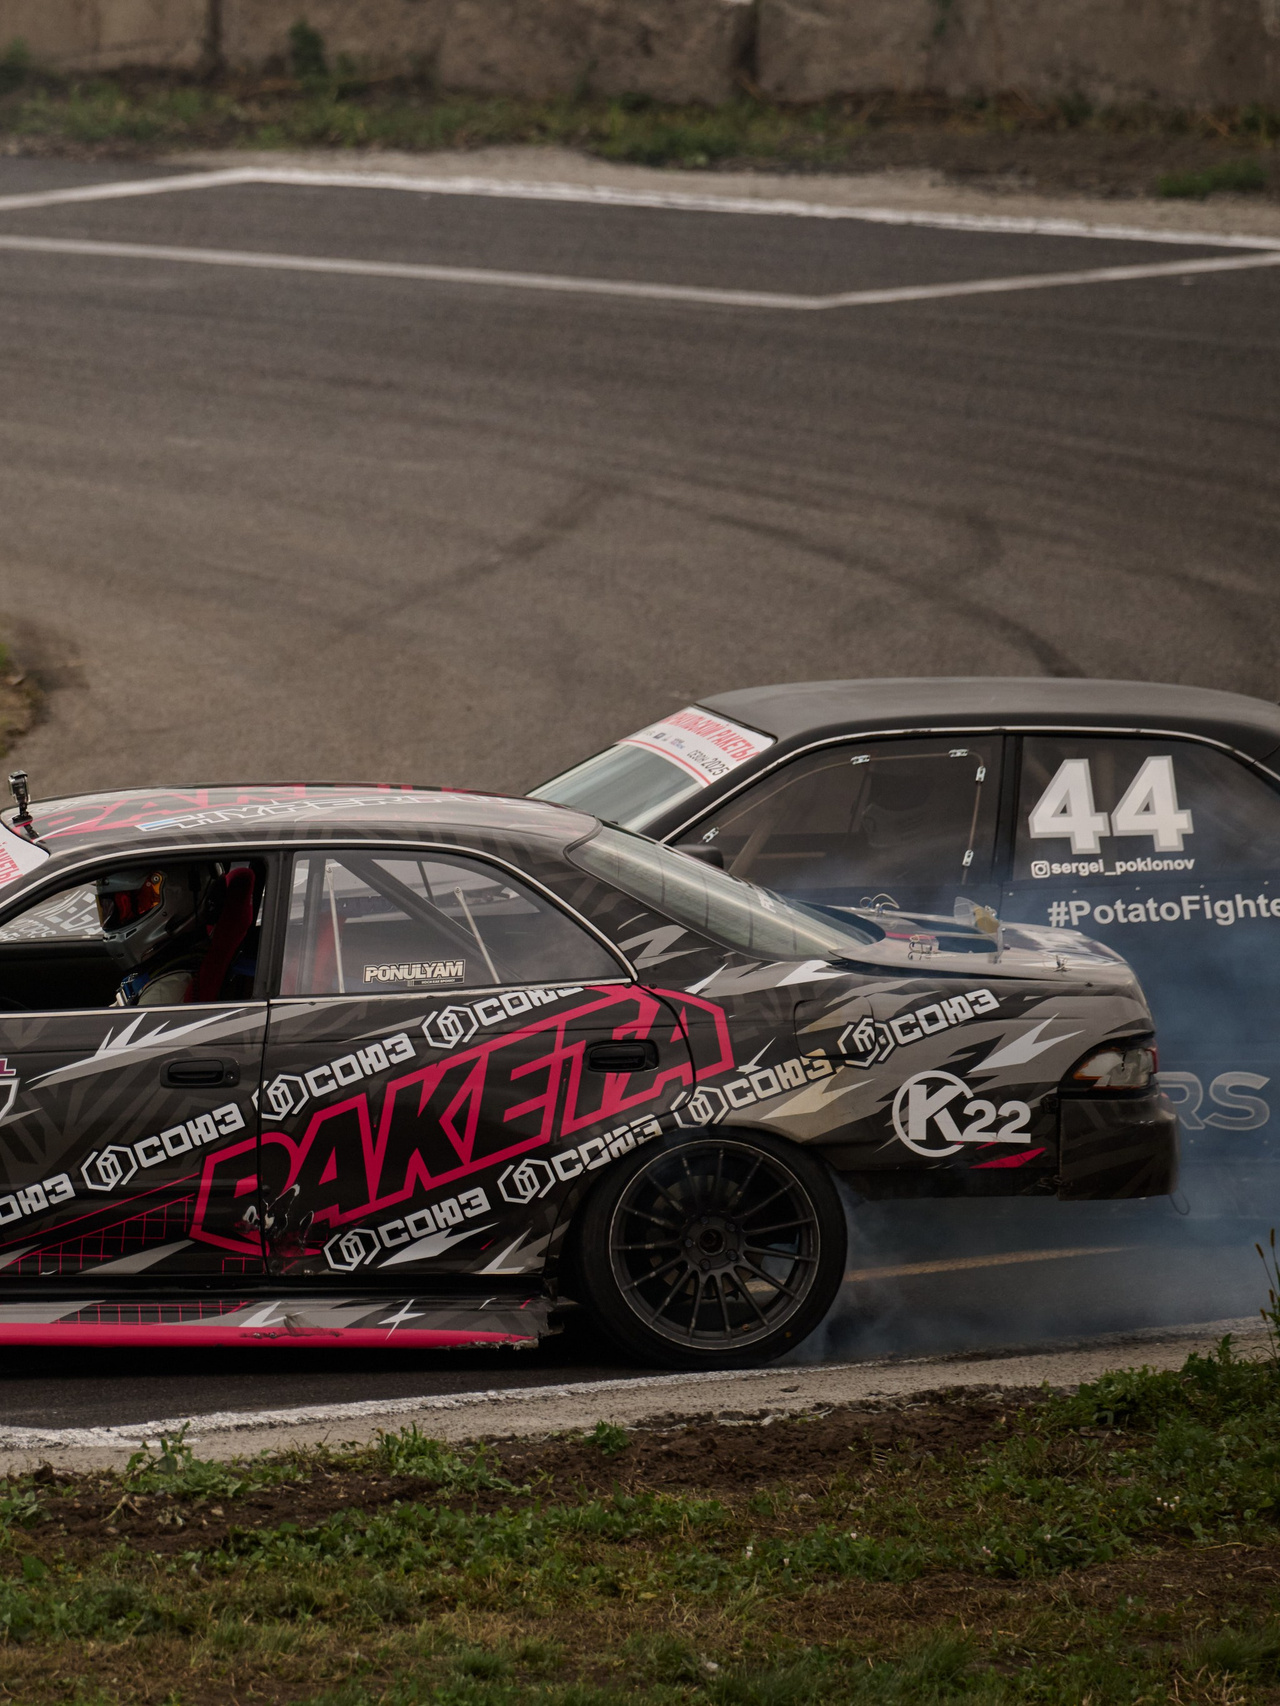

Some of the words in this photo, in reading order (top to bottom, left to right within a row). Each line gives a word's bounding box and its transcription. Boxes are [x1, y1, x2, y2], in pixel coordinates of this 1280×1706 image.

[700, 757, 730, 776] 2025
[1028, 755, 1194, 855] 44
[1051, 857, 1195, 876] sergei_poklonov
[365, 960, 463, 982] PONULYAM
[889, 989, 1000, 1046] СОЮЗ
[304, 1032, 416, 1097] СОЮЗ
[723, 1048, 836, 1109] СОЮЗ
[133, 1103, 245, 1168] СОЮЗ
[189, 984, 735, 1258] РАКЕТА
[895, 1073, 1031, 1155] K22
[550, 1114, 663, 1182] СОЮЗ
[378, 1187, 491, 1248] СОЮЗ
